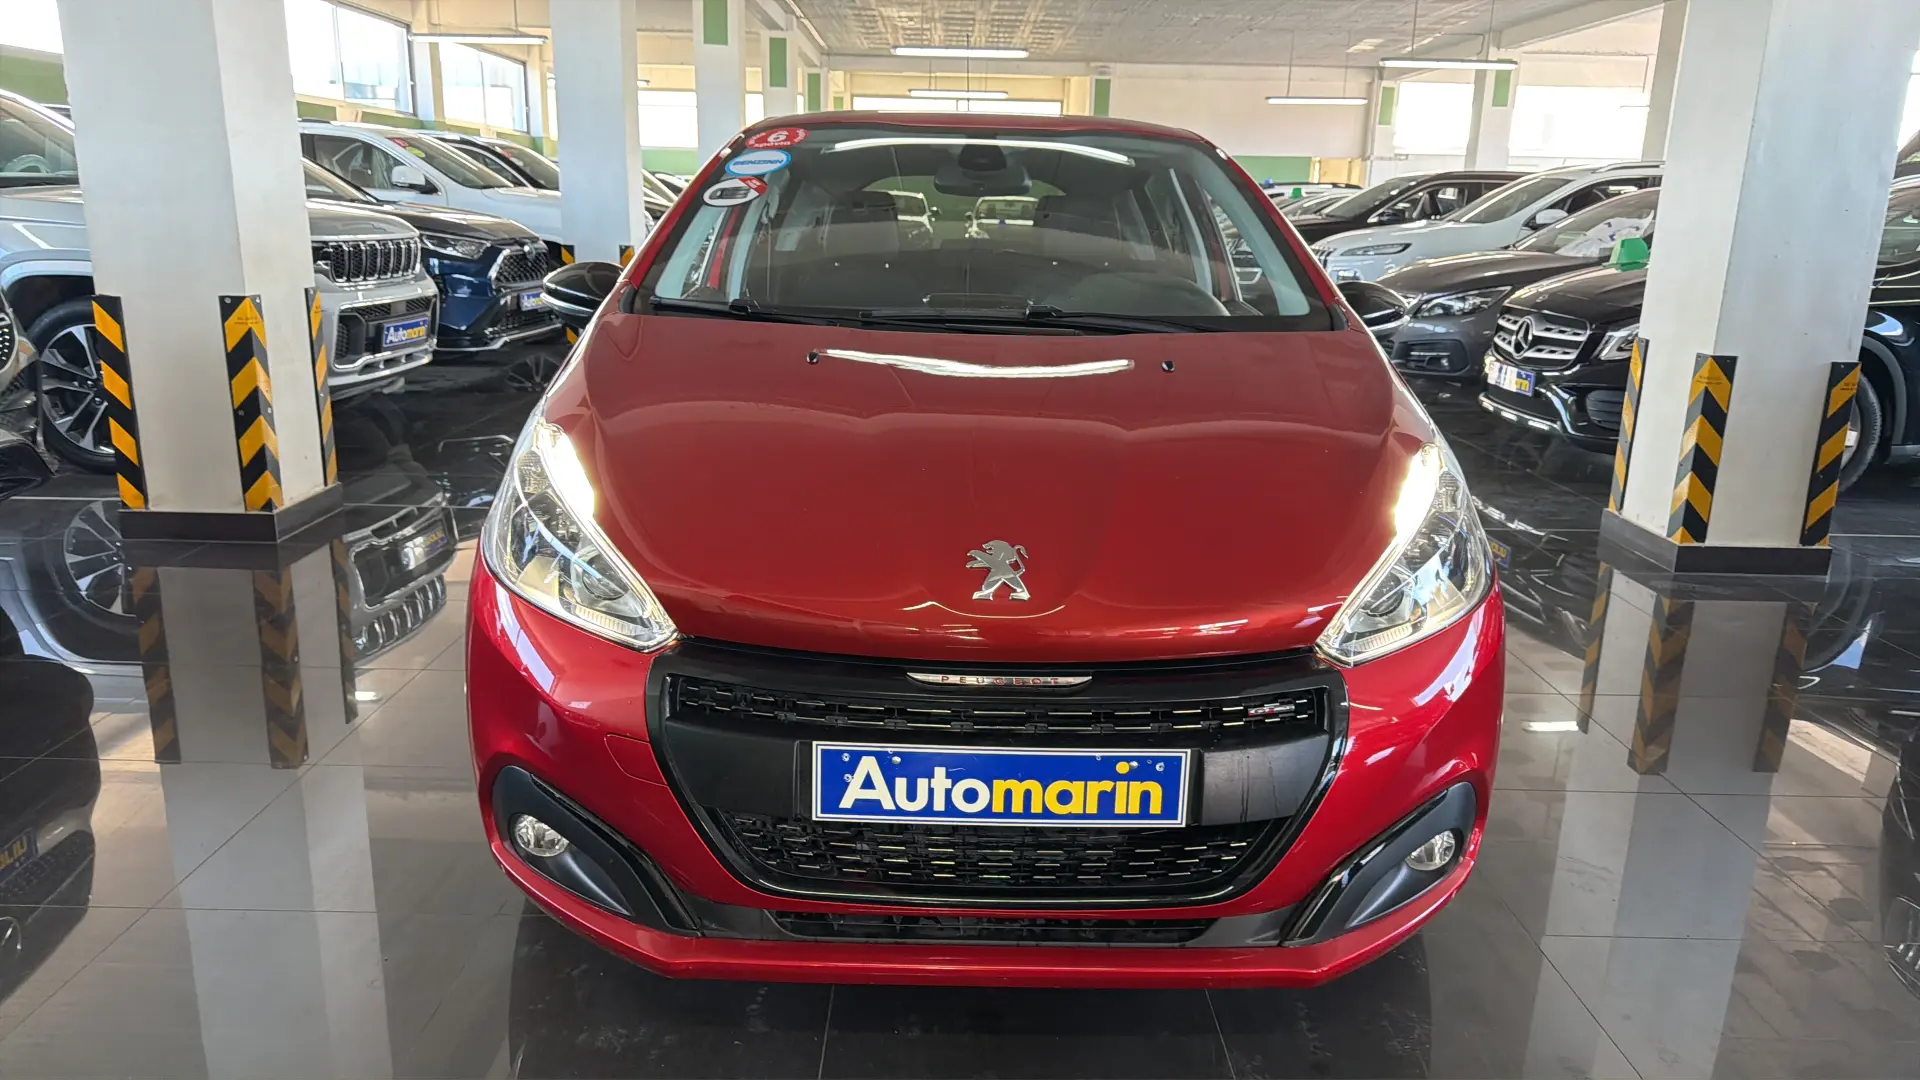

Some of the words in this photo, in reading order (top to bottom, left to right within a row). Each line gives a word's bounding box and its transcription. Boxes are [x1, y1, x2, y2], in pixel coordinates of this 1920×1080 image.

[386, 326, 426, 343] Automarin
[940, 675, 1059, 686] PEUGEOT
[838, 755, 1163, 815] Automarin
